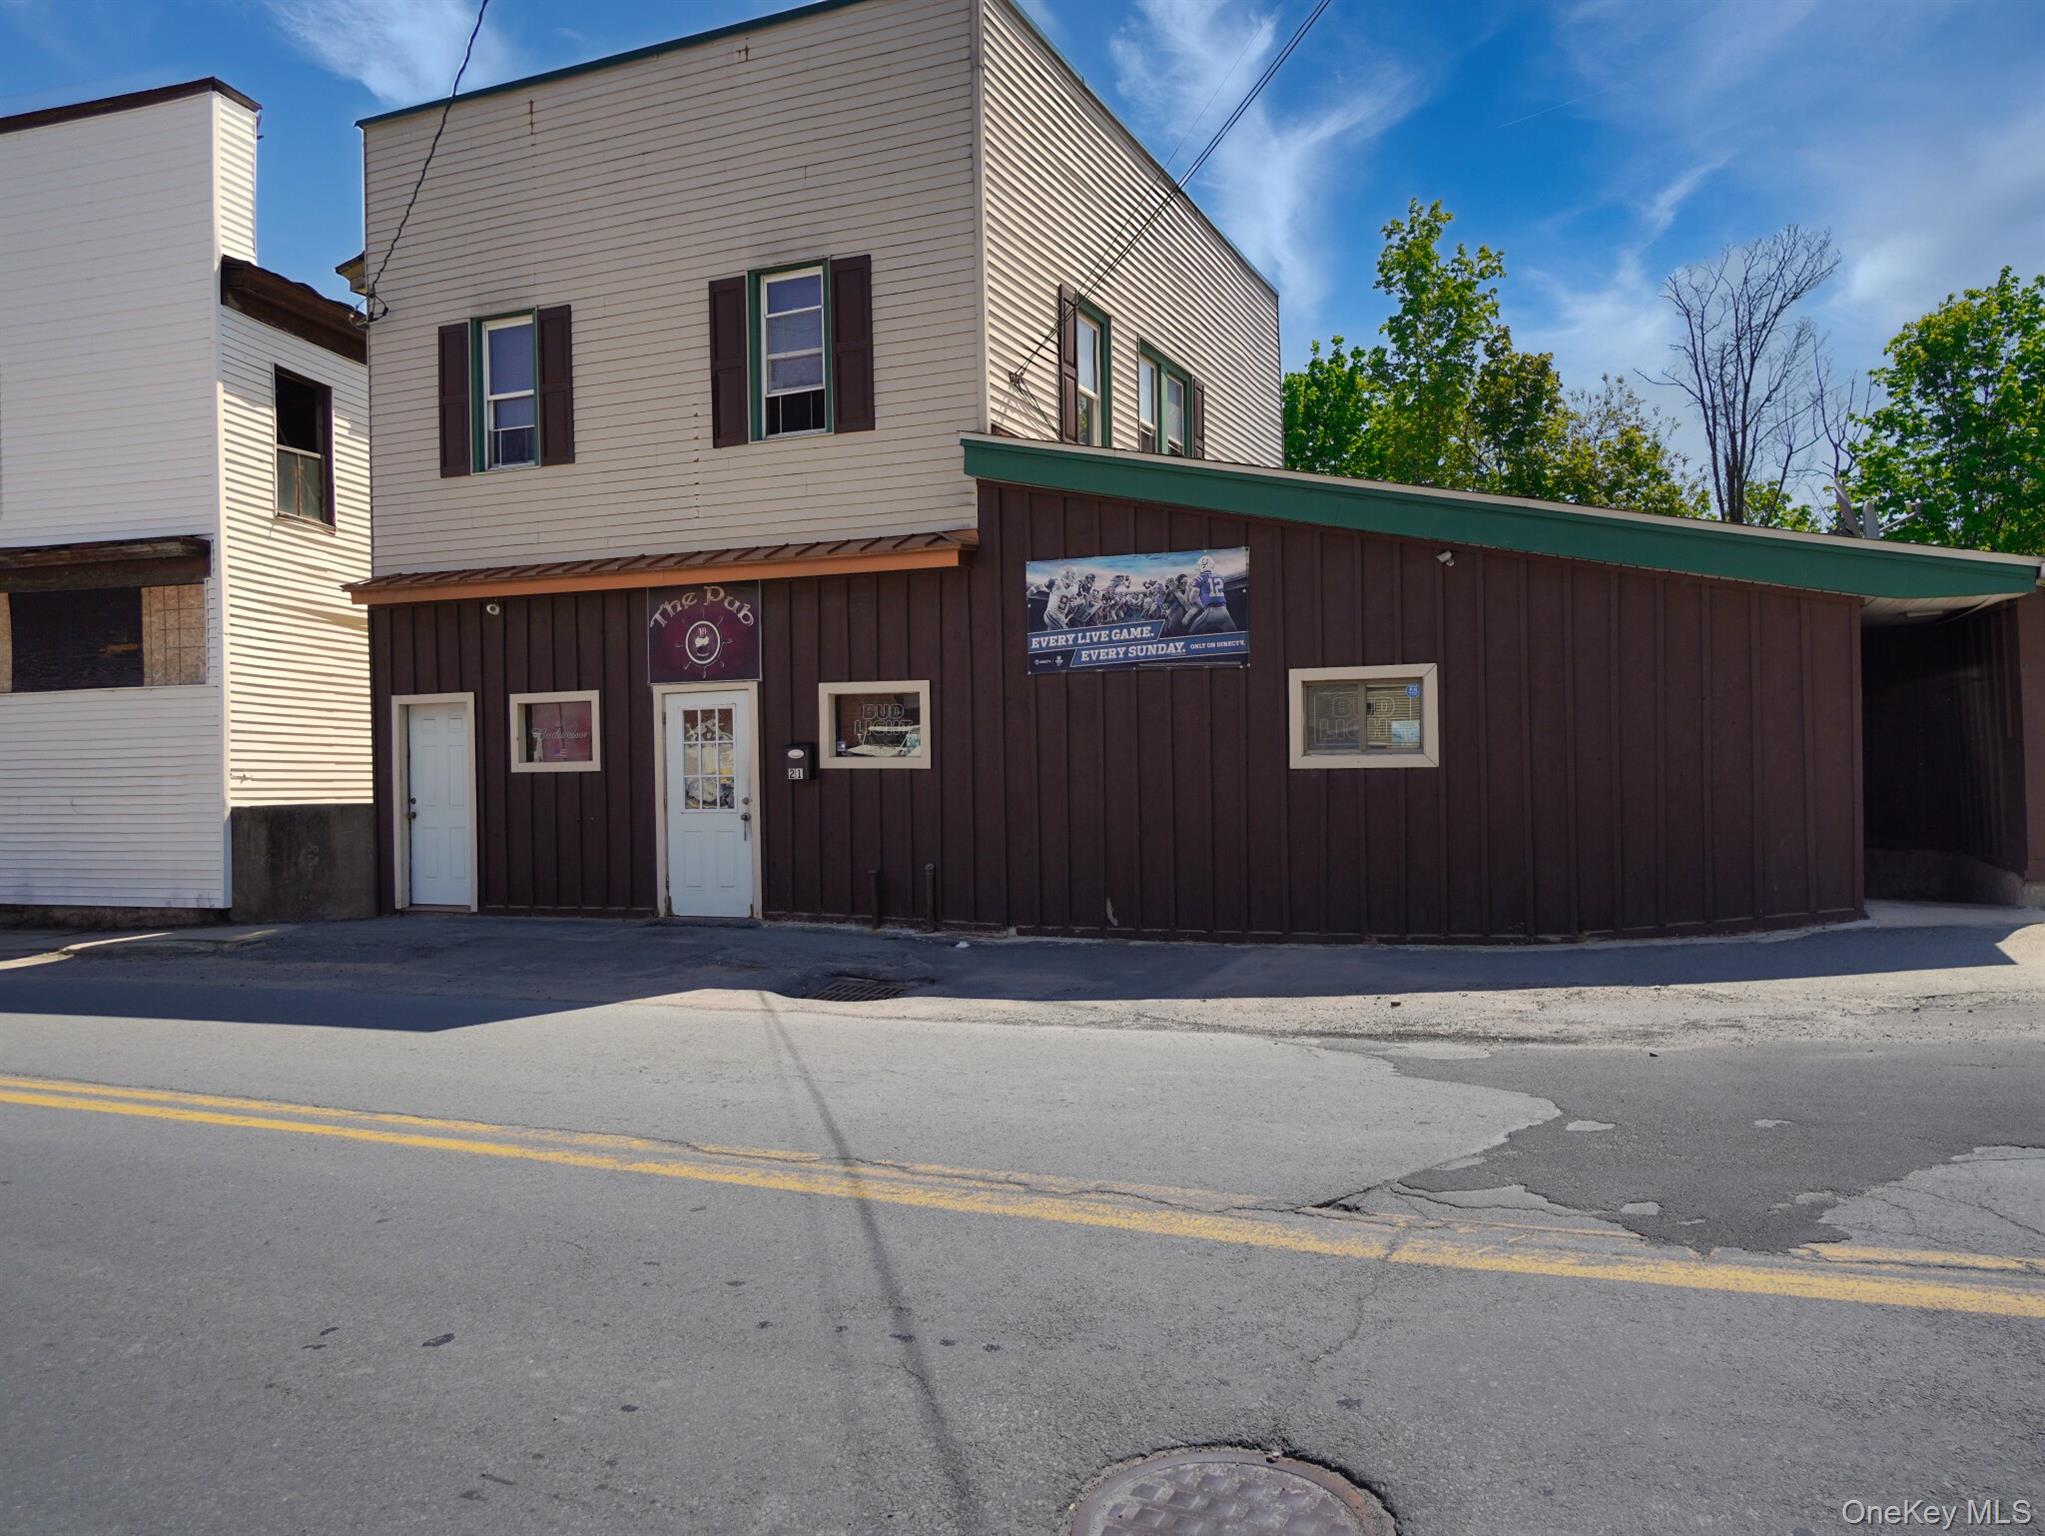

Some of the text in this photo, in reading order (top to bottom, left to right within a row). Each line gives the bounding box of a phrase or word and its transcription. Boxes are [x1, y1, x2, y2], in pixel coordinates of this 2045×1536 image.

[1207, 577, 1224, 597] 12
[650, 586, 754, 628] The Pub
[1031, 626, 1154, 649] EVERY LIVE GAME.
[1080, 642, 1186, 662] EVERY SUNDAY.
[862, 703, 905, 719] BUD
[789, 768, 803, 779] 21
